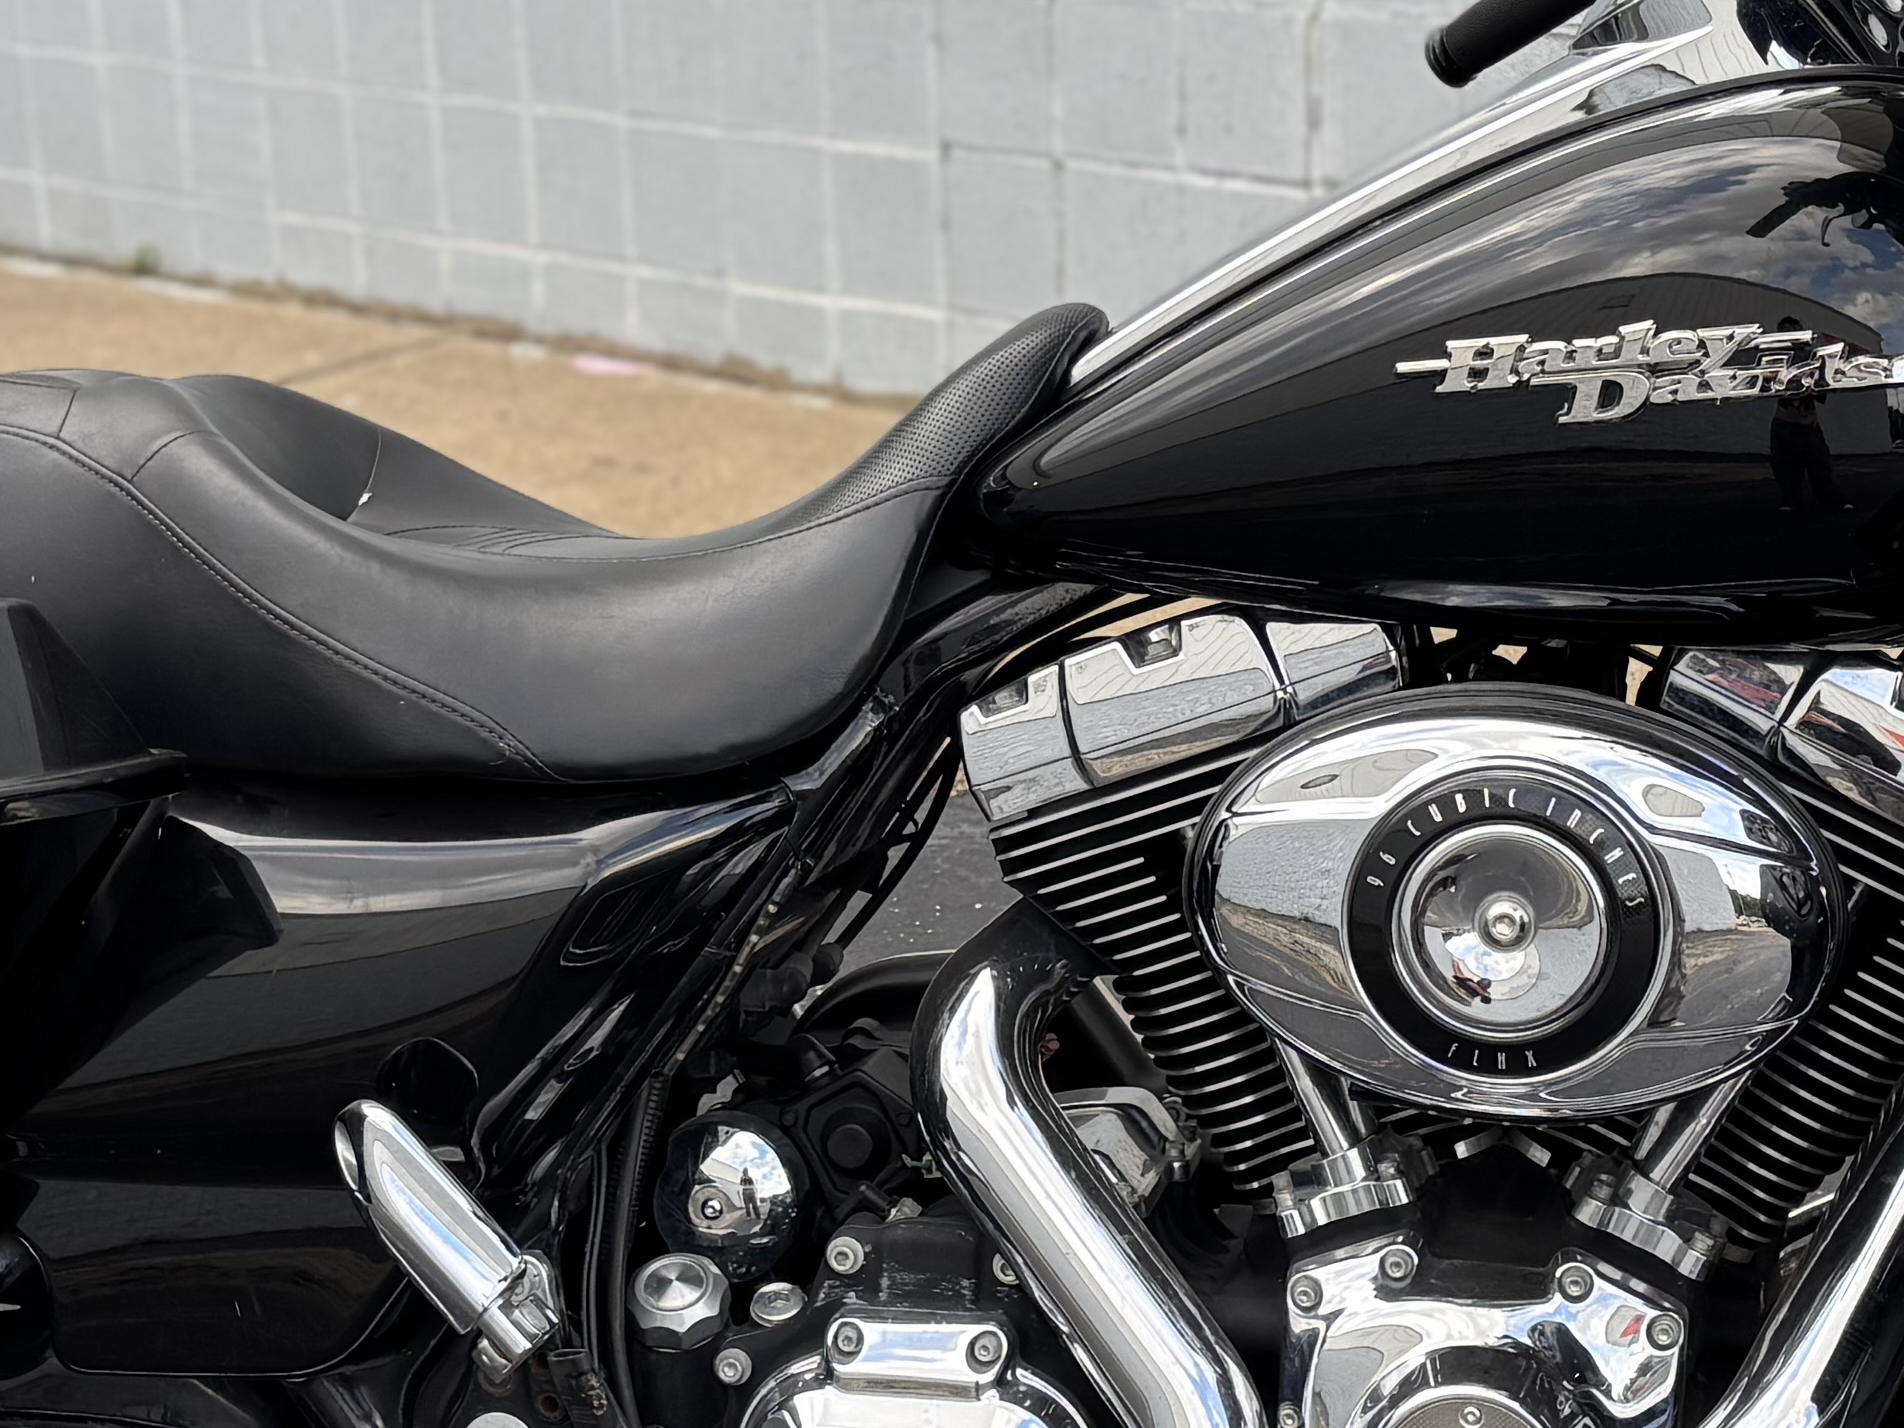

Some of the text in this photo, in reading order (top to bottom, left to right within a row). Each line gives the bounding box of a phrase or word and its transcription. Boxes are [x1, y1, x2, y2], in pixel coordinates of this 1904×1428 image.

[1430, 319, 1766, 394] Harley
[1366, 787, 1645, 907] 96 CUBIC INCHES
[1447, 1043, 1537, 1070] FLHX
